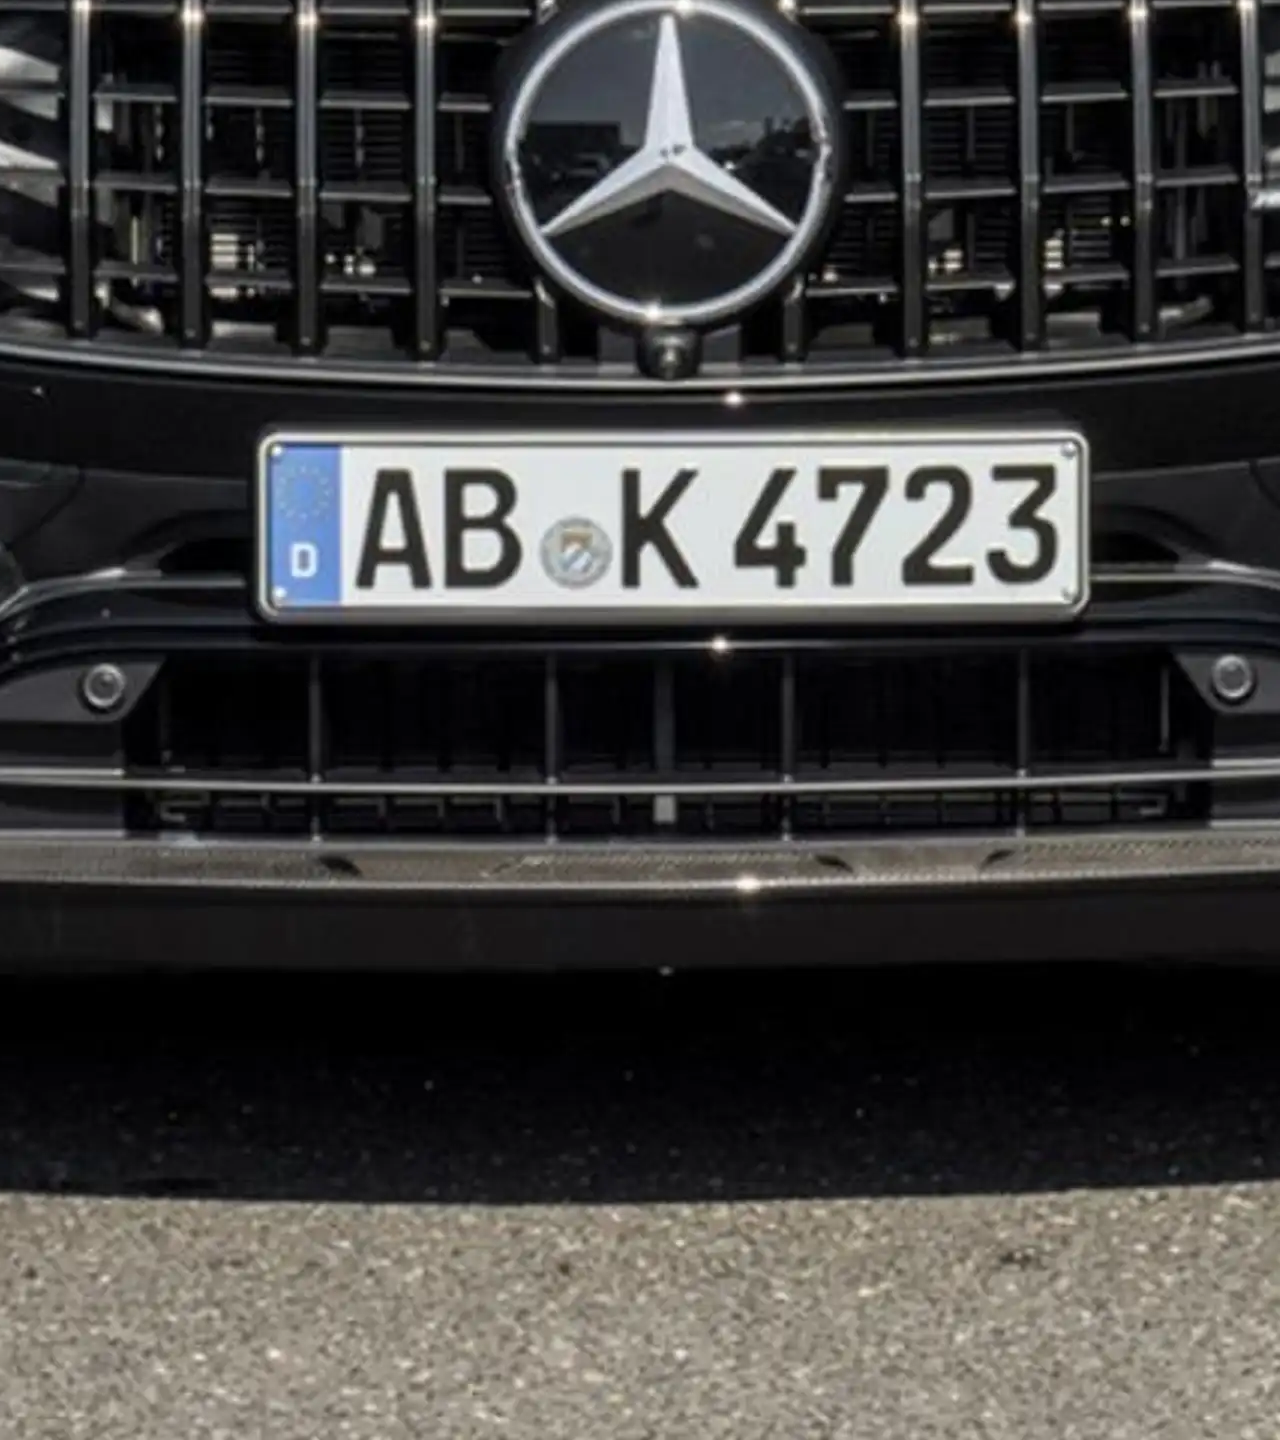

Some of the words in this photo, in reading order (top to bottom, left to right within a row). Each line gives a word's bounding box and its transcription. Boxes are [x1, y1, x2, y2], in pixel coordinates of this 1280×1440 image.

[289, 541, 318, 579] D
[354, 467, 522, 590] AB
[620, 467, 700, 590] K
[732, 463, 1060, 590] 4723
